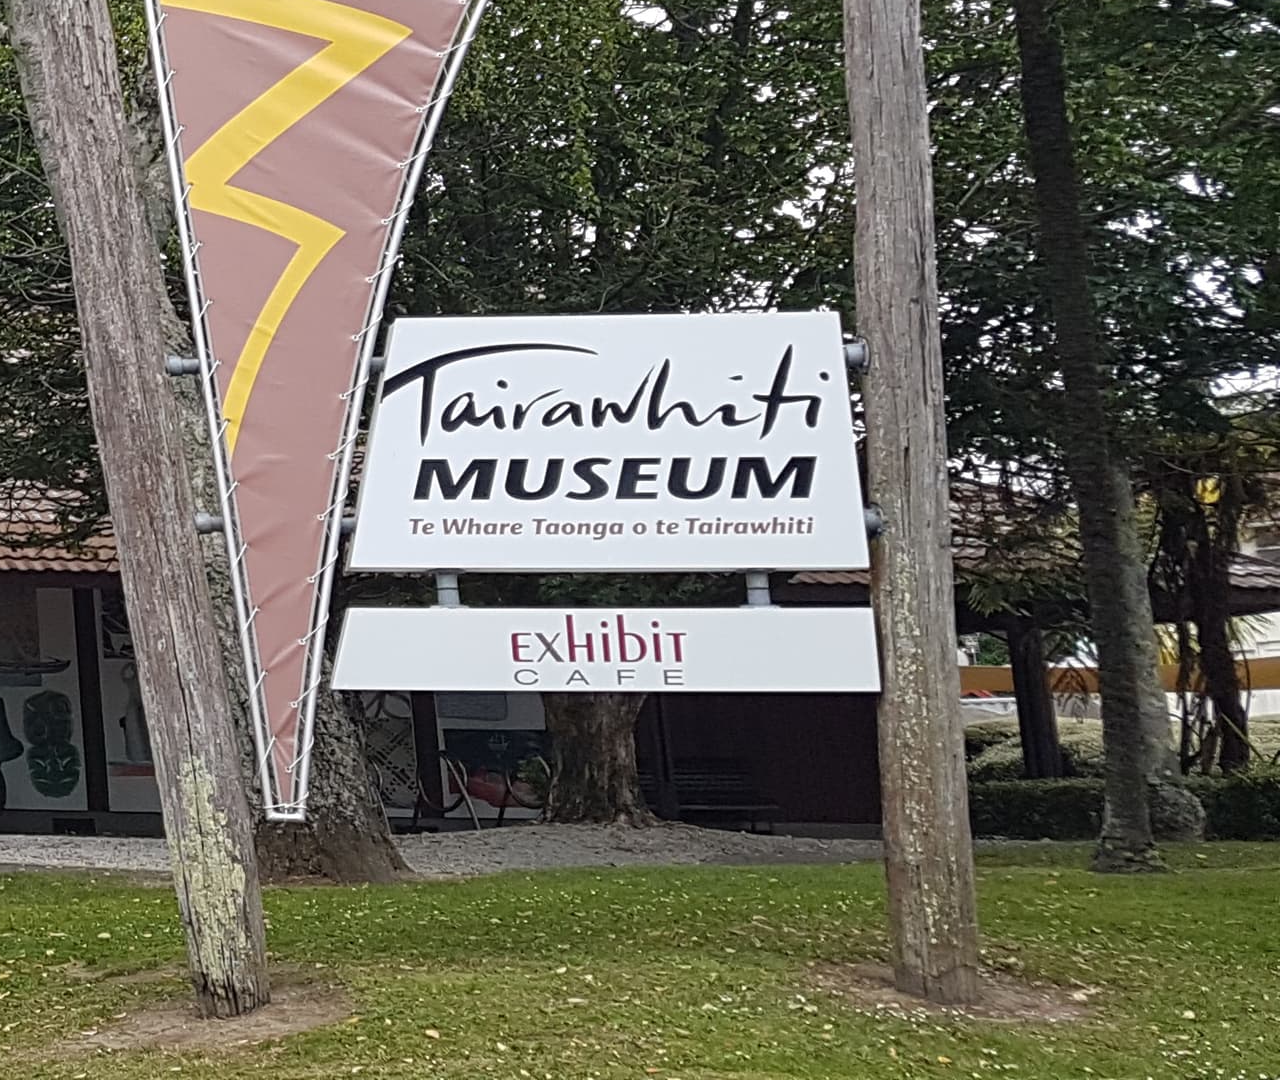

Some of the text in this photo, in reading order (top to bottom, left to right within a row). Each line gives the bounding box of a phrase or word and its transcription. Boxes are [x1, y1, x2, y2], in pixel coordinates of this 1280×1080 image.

[381, 343, 831, 447] Tairawhiti
[413, 456, 817, 501] MUSEUM
[410, 517, 815, 541] Te Whare Taonga o te Tairawhiti
[513, 669, 685, 686] CAFE
